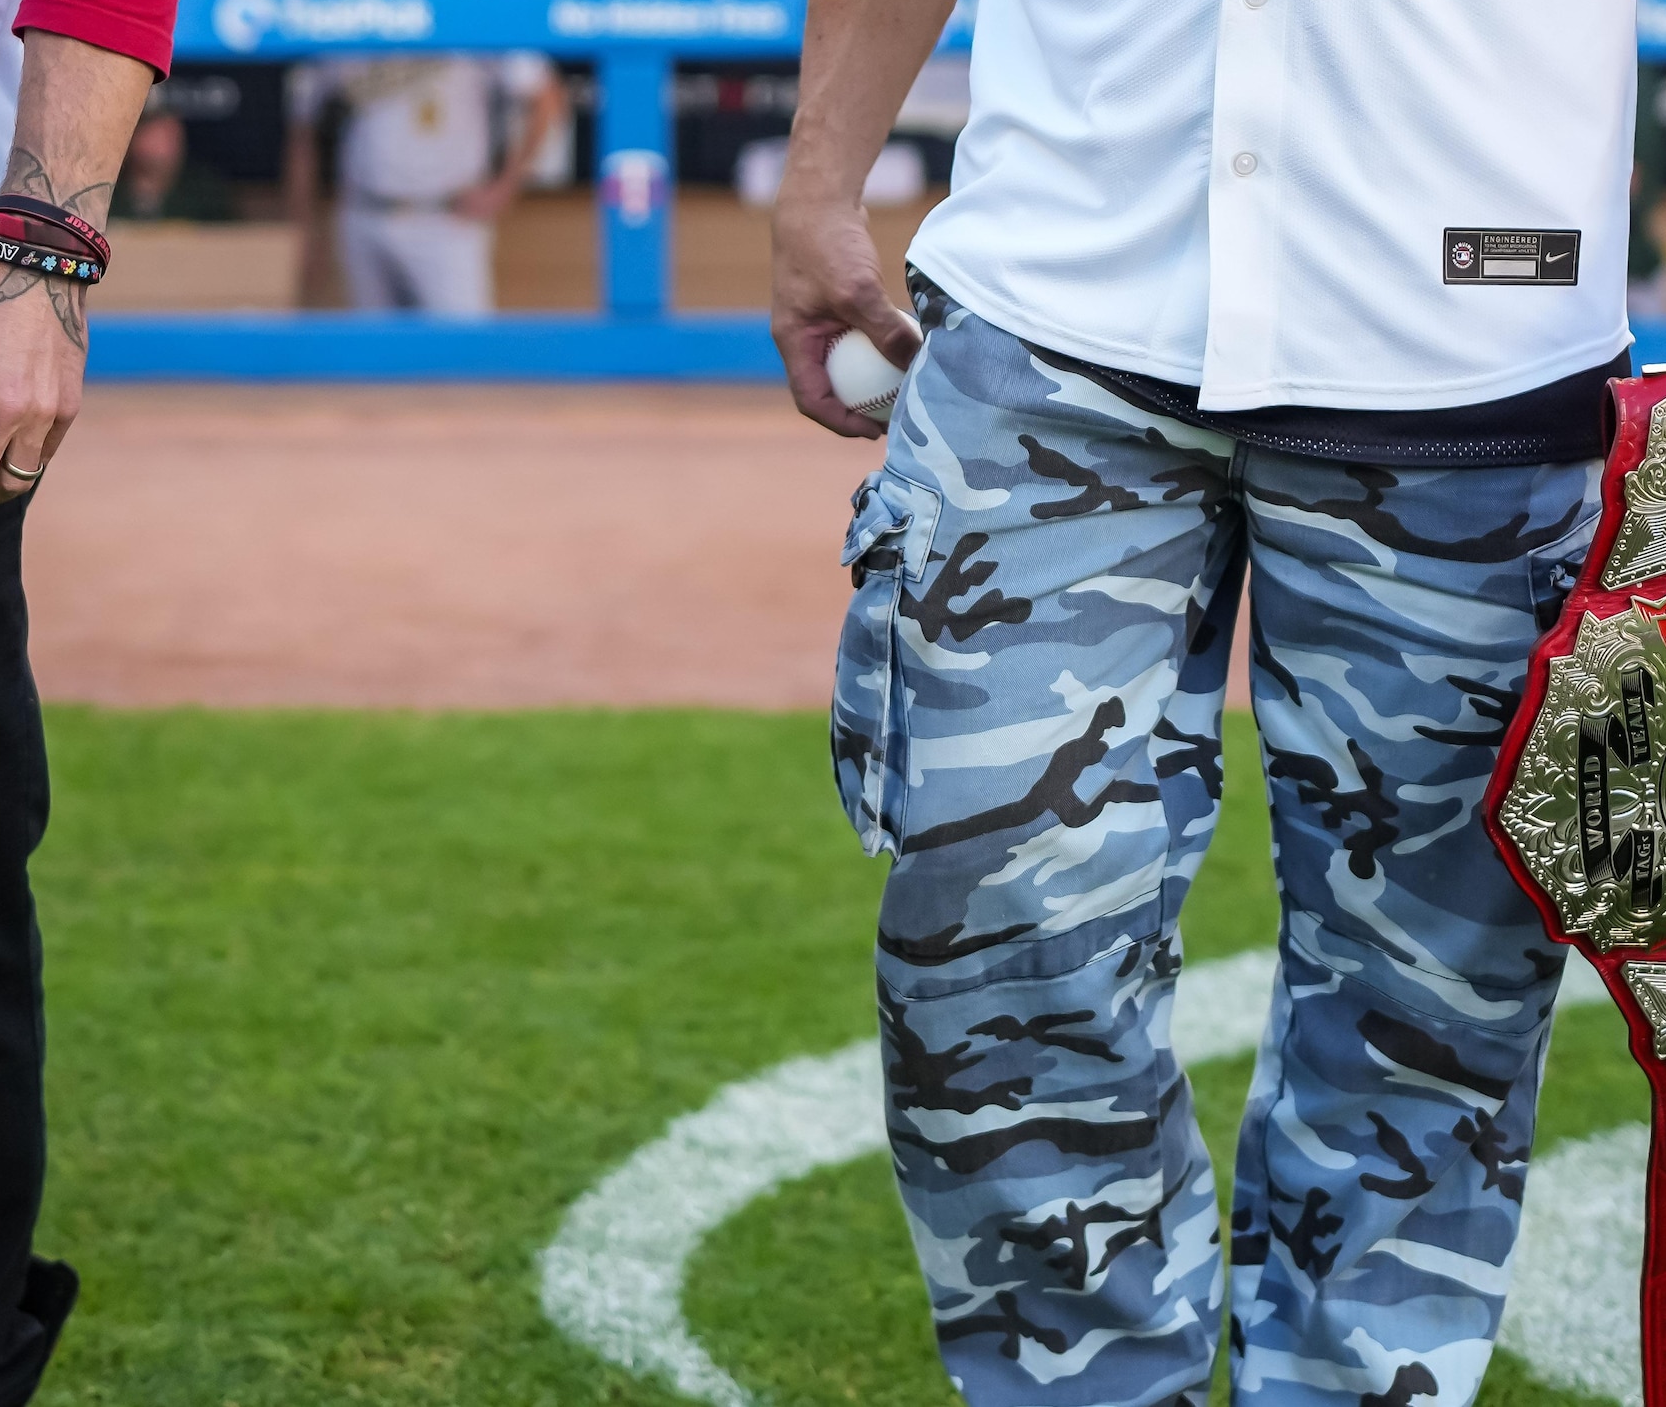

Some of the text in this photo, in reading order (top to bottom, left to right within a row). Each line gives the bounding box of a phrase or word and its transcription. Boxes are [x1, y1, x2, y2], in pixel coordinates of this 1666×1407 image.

[65, 215, 95, 239] Fear
[1484, 235, 1537, 244] ENGINEERED
[1583, 756, 1605, 851] WORLD
[1625, 696, 1651, 882] TAG TEAM
